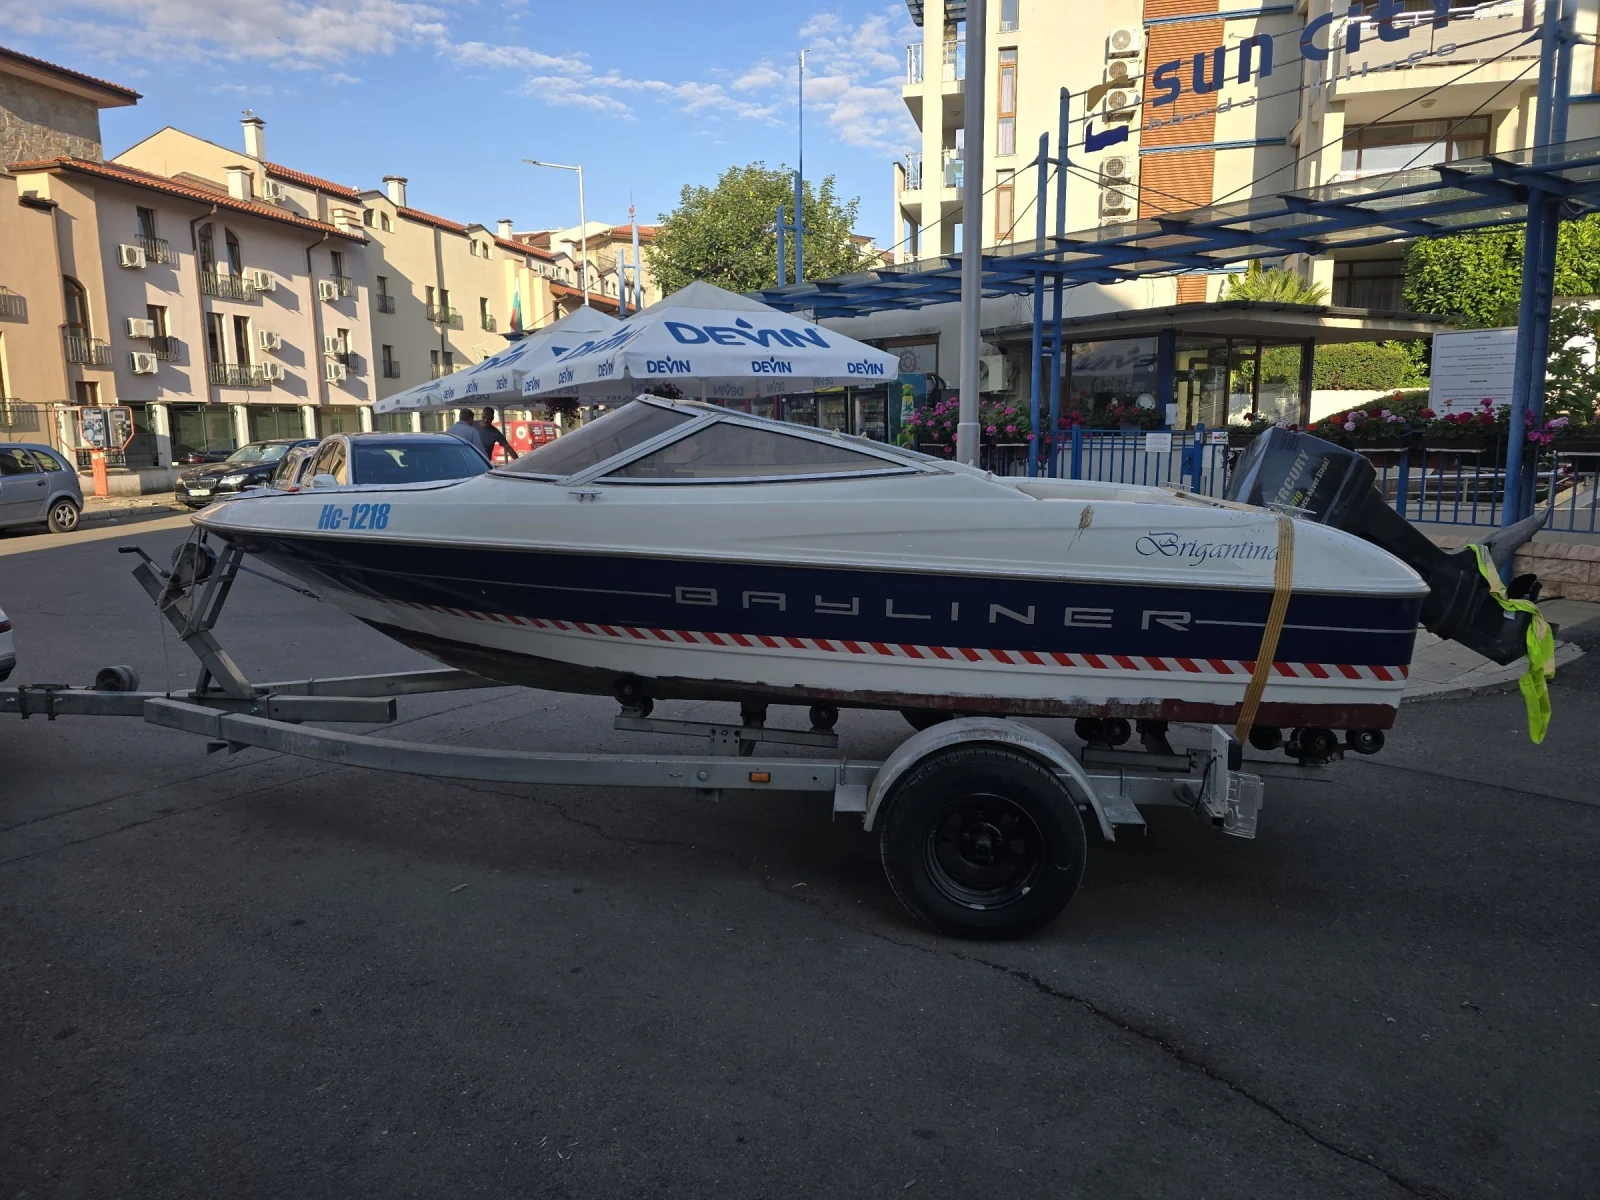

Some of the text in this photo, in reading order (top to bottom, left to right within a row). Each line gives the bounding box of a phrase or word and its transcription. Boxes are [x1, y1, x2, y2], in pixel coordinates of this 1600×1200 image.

[1152, 32, 1274, 107] sun
[664, 319, 831, 349] DEVIN
[597, 361, 615, 378] DEVIN
[646, 357, 692, 374] DEVIN
[751, 358, 793, 374] DEVIN
[847, 361, 885, 376] DEVIN
[524, 377, 541, 392] DEVIN
[558, 368, 574, 385] DEVIN
[465, 380, 479, 394] DEVIN
[675, 586, 1191, 632] BAYLINER
